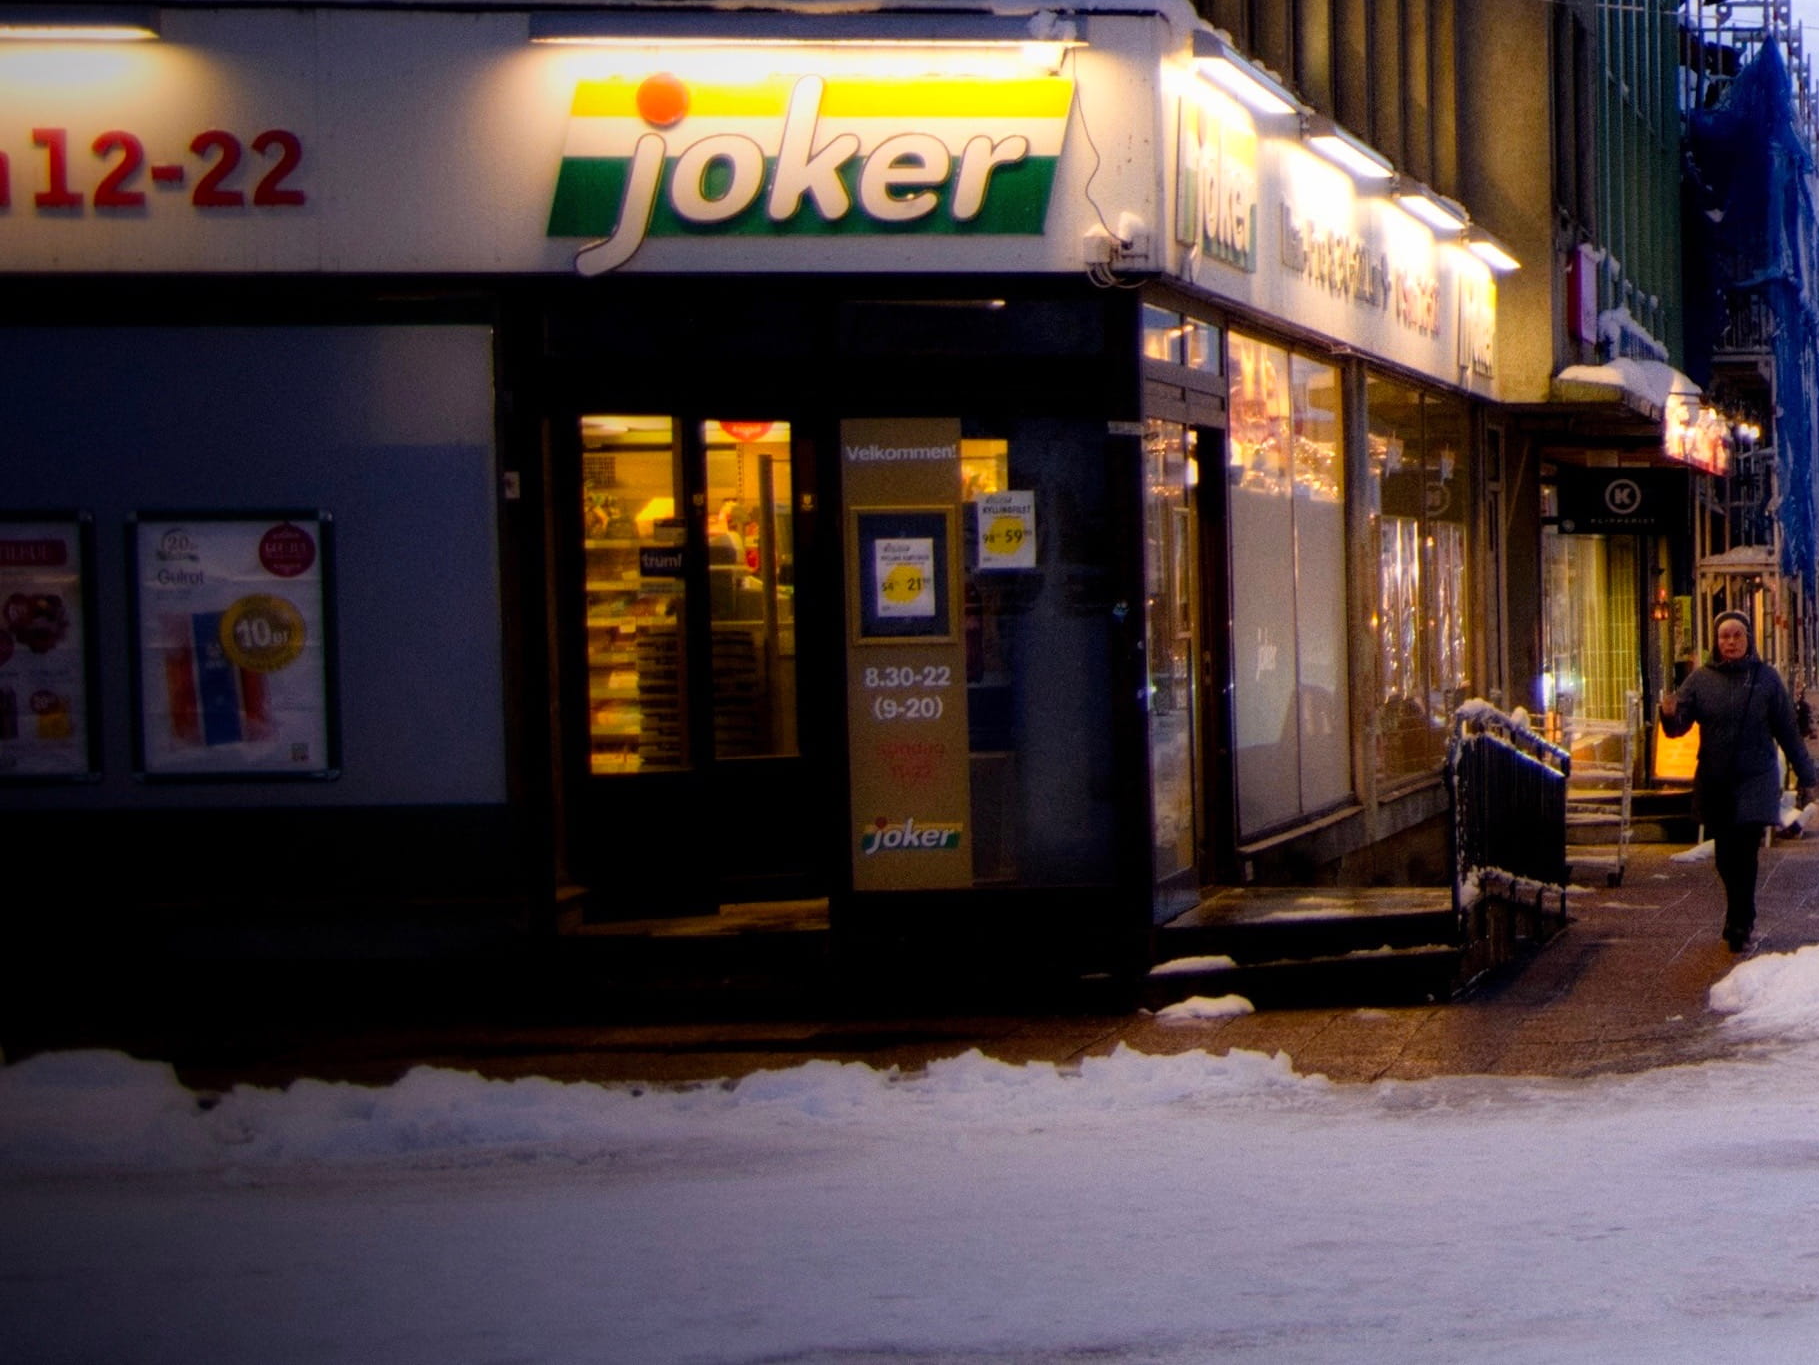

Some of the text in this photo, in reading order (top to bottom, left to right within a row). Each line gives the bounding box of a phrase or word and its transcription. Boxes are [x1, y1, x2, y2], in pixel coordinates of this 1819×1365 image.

[32, 128, 305, 207] 12-22
[575, 72, 1030, 276] joker
[846, 444, 957, 461] Velkommen!
[865, 665, 951, 687] 8.30-22
[874, 696, 944, 720] (9-20)
[865, 817, 955, 855] joker
